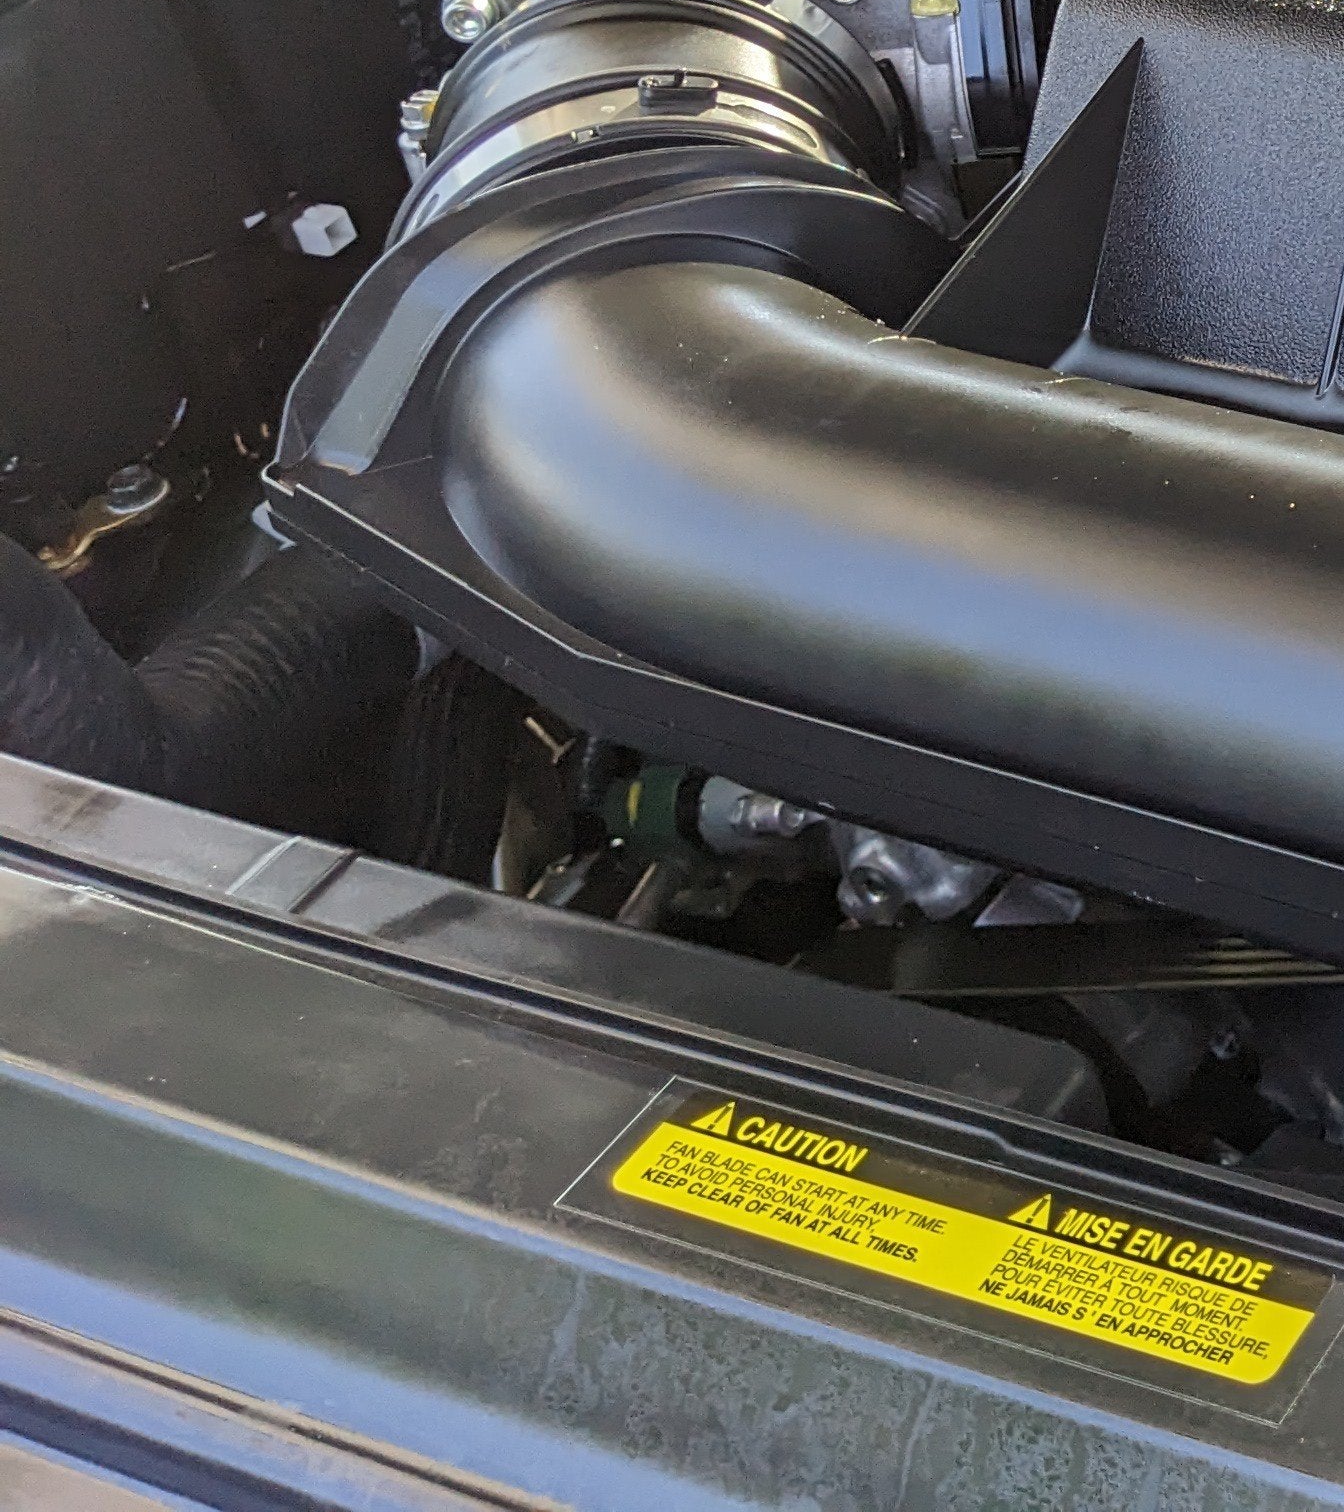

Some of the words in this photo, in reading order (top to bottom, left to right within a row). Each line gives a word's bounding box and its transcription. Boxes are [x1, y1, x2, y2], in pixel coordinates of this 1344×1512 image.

[656, 1154, 679, 1172] TO
[678, 1161, 731, 1186] AVOID
[731, 1177, 816, 1214] PERSONAL
[737, 1117, 869, 1172] CAUTION
[642, 1167, 688, 1190] KEEP
[687, 1183, 745, 1207] CLEAR
[745, 1199, 772, 1216] OF
[770, 1207, 806, 1227] FAN
[806, 1217, 830, 1236] AT
[827, 1226, 861, 1246] ALL
[869, 1236, 919, 1263] TIMES.
[665, 1140, 702, 1162] FAN
[702, 1150, 753, 1176] BLADE
[755, 1167, 792, 1188] CAN
[791, 1178, 851, 1204] START
[848, 1192, 870, 1209] AT
[866, 1197, 909, 1222] ANY
[907, 1211, 948, 1236] TIME.
[1012, 1234, 1038, 1250] LE
[1042, 1238, 1159, 1284] VENTILATEUR
[1159, 1274, 1226, 1309] RISQUE
[1229, 1297, 1259, 1316] DE
[1054, 1208, 1128, 1250] MISE
[1123, 1229, 1173, 1262] EN
[1168, 1241, 1273, 1291] GARDE
[978, 1279, 1004, 1298] NE
[1004, 1287, 1073, 1316] JAMAIS
[1120, 1323, 1234, 1365] APPROCHER
[990, 1263, 1043, 1288] POUR
[1110, 1299, 1170, 1328] TOUTE
[1170, 1317, 1270, 1359] BLESSURE,
[1116, 1282, 1162, 1306] TOUT
[1169, 1299, 1250, 1332] MOMENT.
